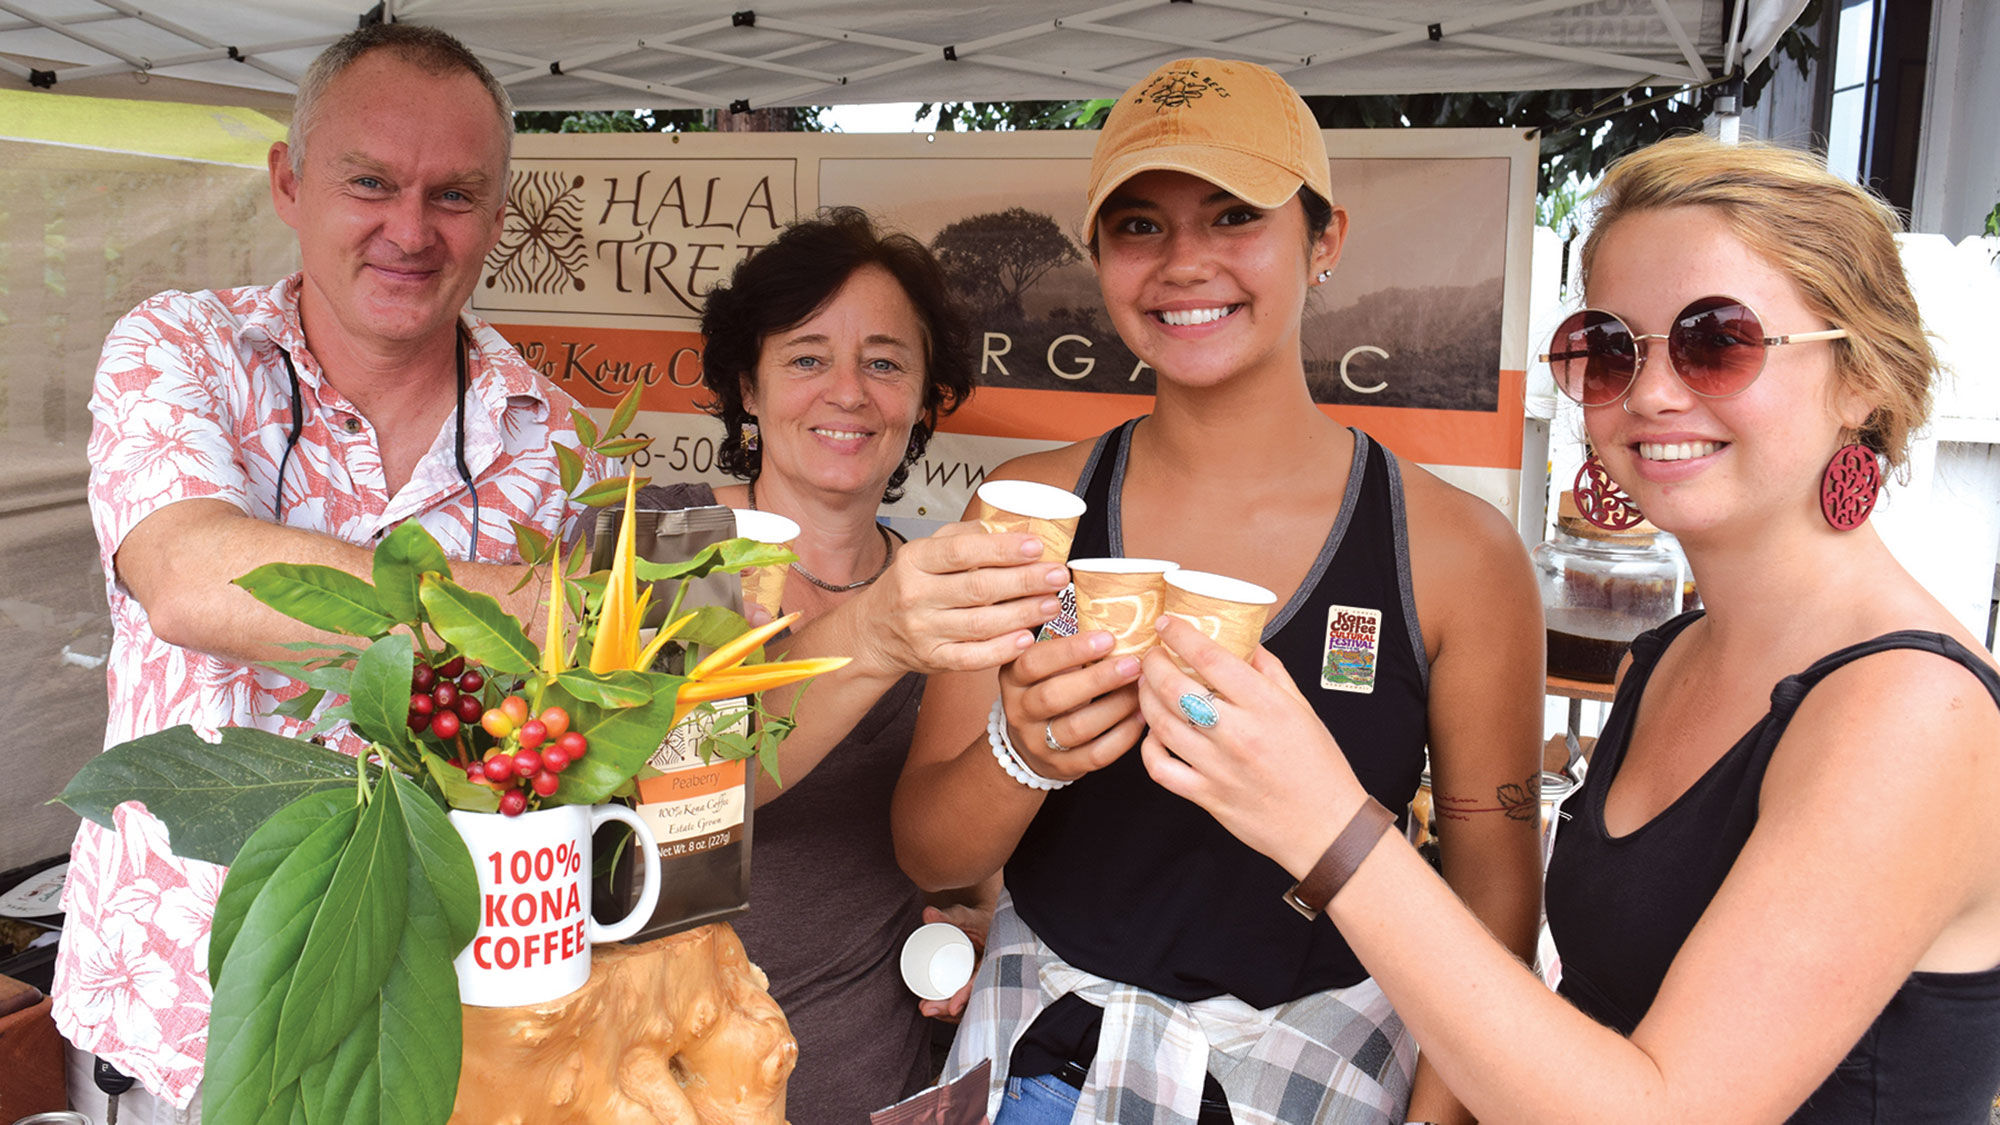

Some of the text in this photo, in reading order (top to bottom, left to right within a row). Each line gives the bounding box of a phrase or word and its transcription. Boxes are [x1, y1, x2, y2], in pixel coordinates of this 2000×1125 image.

[598, 170, 783, 238] HALA
[561, 341, 663, 396] Kona
[1330, 619, 1376, 634] Coffee
[1337, 611, 1376, 625] Kona
[1328, 637, 1375, 650] FESTIVAL
[1329, 630, 1375, 643] CULTURAL
[672, 771, 720, 790] Peaberry
[658, 806, 683, 819] 100%
[684, 804, 705, 816] Kona
[668, 817, 722, 835] Estate Grown
[688, 841, 694, 852] 8
[708, 831, 731, 849] (227g)
[488, 839, 581, 885] 100%
[485, 881, 581, 927] KONA
[473, 918, 585, 970] COFFEE
